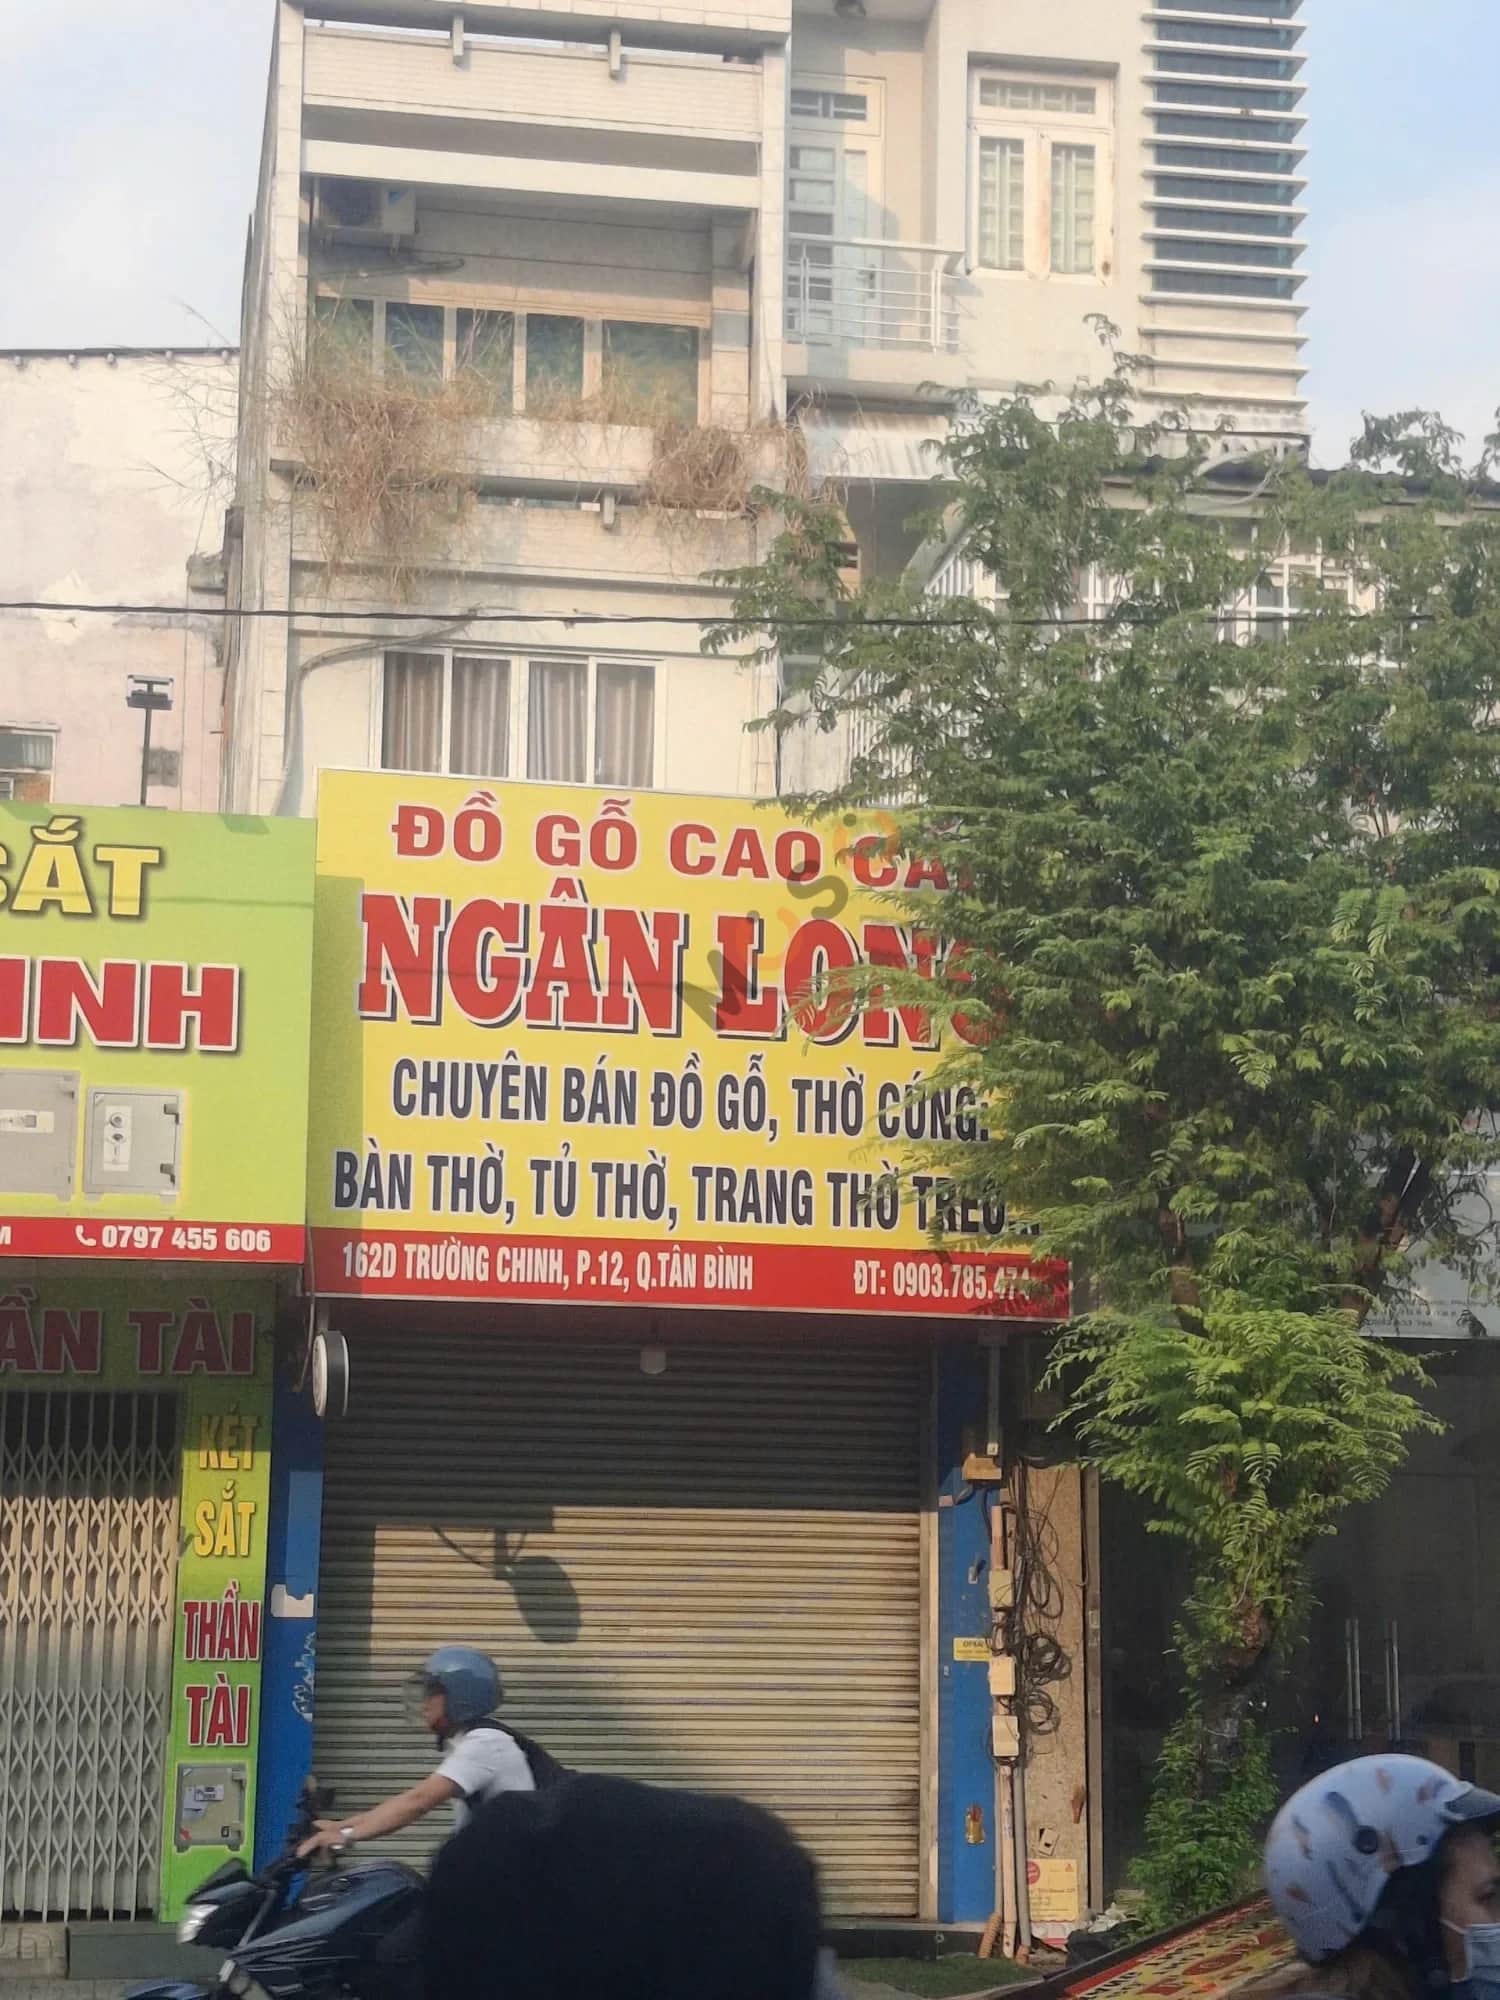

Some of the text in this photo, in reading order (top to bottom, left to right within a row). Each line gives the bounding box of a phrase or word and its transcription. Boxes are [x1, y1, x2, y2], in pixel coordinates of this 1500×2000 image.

[0, 815, 162, 918] ẮT
[391, 790, 502, 862] ĐỒ
[535, 797, 638, 871] GỖ
[669, 823, 822, 883] CAO
[357, 876, 690, 1039] NGÂN
[392, 1049, 548, 1122] CHUYÊN
[562, 1054, 638, 1126] BÁN
[650, 1052, 702, 1130] ĐỒ
[717, 1053, 778, 1142] GỖ,
[791, 1066, 865, 1138] THỜ
[334, 1137, 412, 1211] BÀN
[426, 1142, 516, 1225] THỜ,
[529, 1141, 577, 1218] TỦ
[590, 1149, 679, 1232] THỜ,
[691, 1165, 814, 1227] TRANG
[826, 1159, 900, 1230] THỜ
[102, 1225, 271, 1252] 0797 455 606
[342, 1235, 754, 1293] 162D TRƯỜNG CHINH, P.12, Q.TÂN BÌNH
[853, 1259, 888, 1296] ĐT:
[127, 1295, 255, 1376] TÀI
[199, 1403, 262, 1471] KÉT
[193, 1478, 257, 1557] SẮT
[182, 1576, 262, 1663] THẦN
[183, 1671, 253, 1747] TÀI
